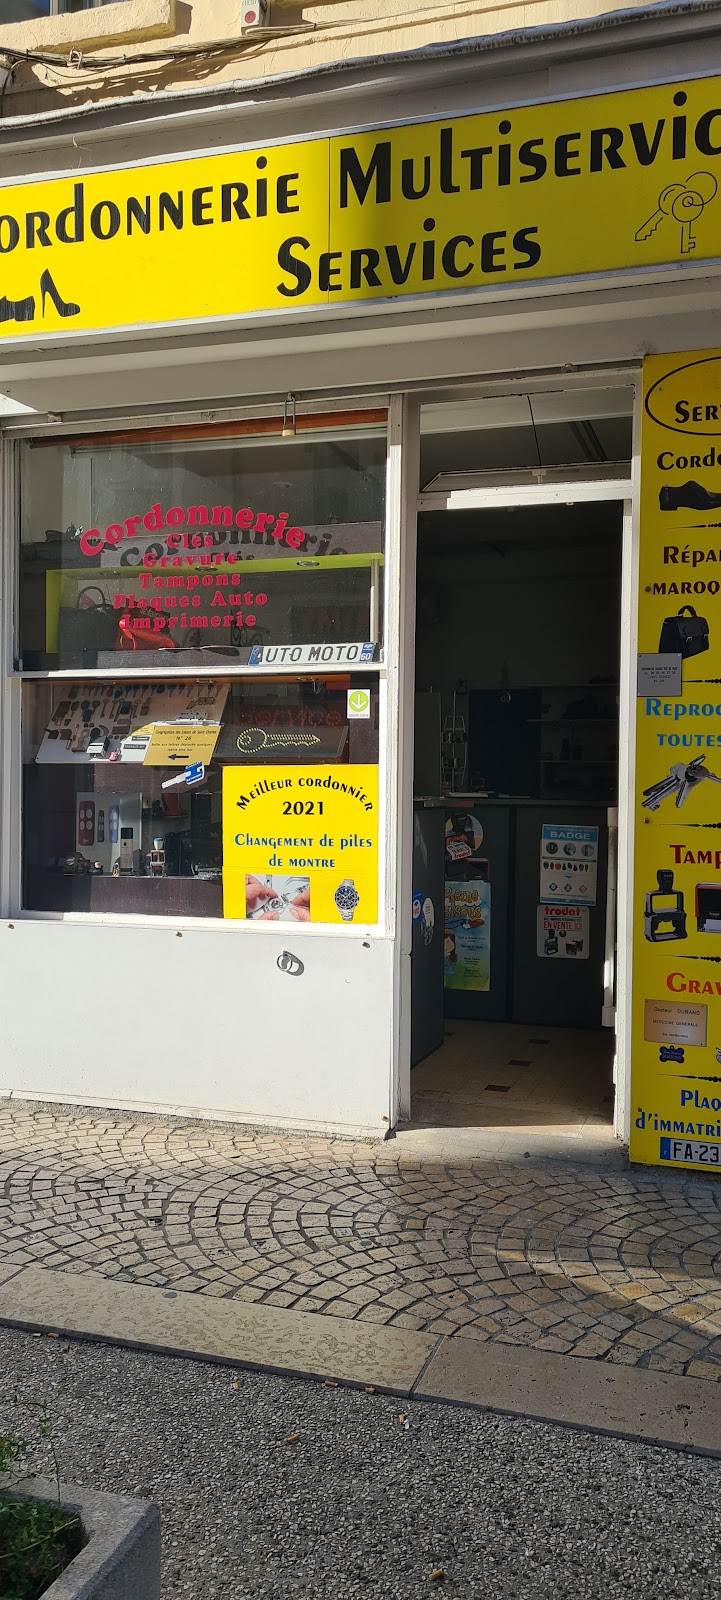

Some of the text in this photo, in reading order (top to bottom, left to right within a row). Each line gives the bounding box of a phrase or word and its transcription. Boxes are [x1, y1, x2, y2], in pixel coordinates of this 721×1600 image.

[675, 400, 721, 424] Ser
[79, 503, 305, 557] Cordonnerie
[166, 531, 214, 549] Clés
[142, 552, 238, 569] Gravure
[663, 544, 721, 567] Répa
[138, 573, 241, 591] Tampons
[113, 591, 268, 612] Plaques Auto
[123, 613, 257, 631] Imprimerie
[254, 645, 359, 663] AUTO MOTO
[282, 801, 325, 816] 2021
[234, 834, 373, 850] Changement de piles
[550, 831, 591, 840] BADGE
[268, 853, 336, 868] de montre
[544, 906, 581, 916] trodat
[544, 921, 552, 929] EN
[553, 921, 573, 930] VENTE
[676, 1008, 701, 1016] DURAND
[673, 1142, 719, 1162] FA-23
